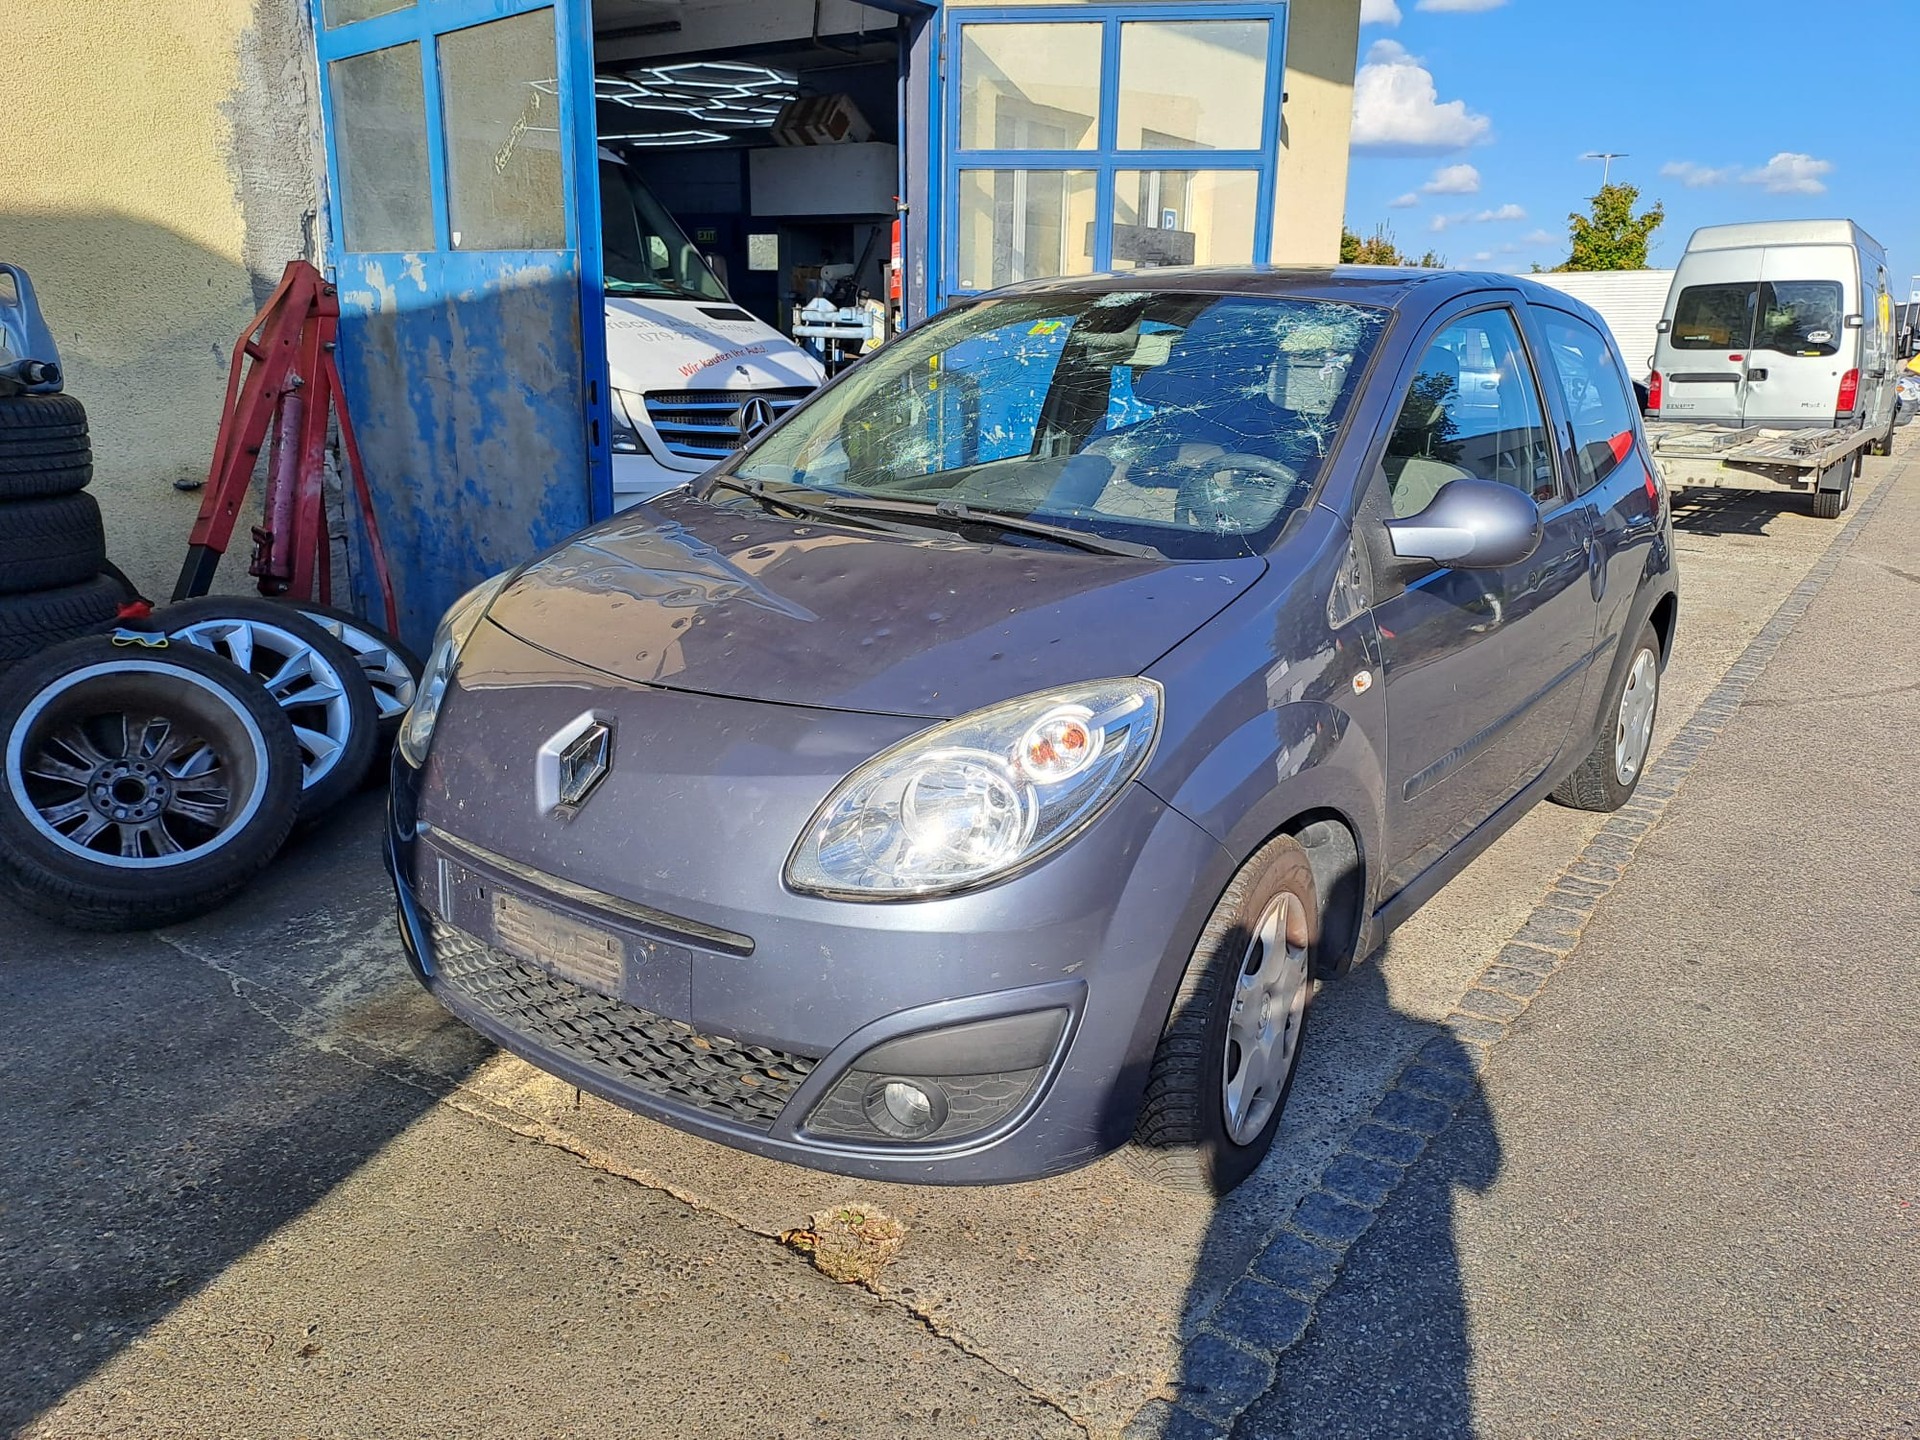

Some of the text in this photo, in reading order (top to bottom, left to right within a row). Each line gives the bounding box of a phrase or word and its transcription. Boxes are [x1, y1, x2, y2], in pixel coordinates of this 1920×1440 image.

[697, 230, 716, 241] EXIT
[637, 331, 674, 342] 079
[678, 360, 700, 377] Wir
[698, 351, 733, 369] kaufen
[730, 347, 747, 358] Ihr
